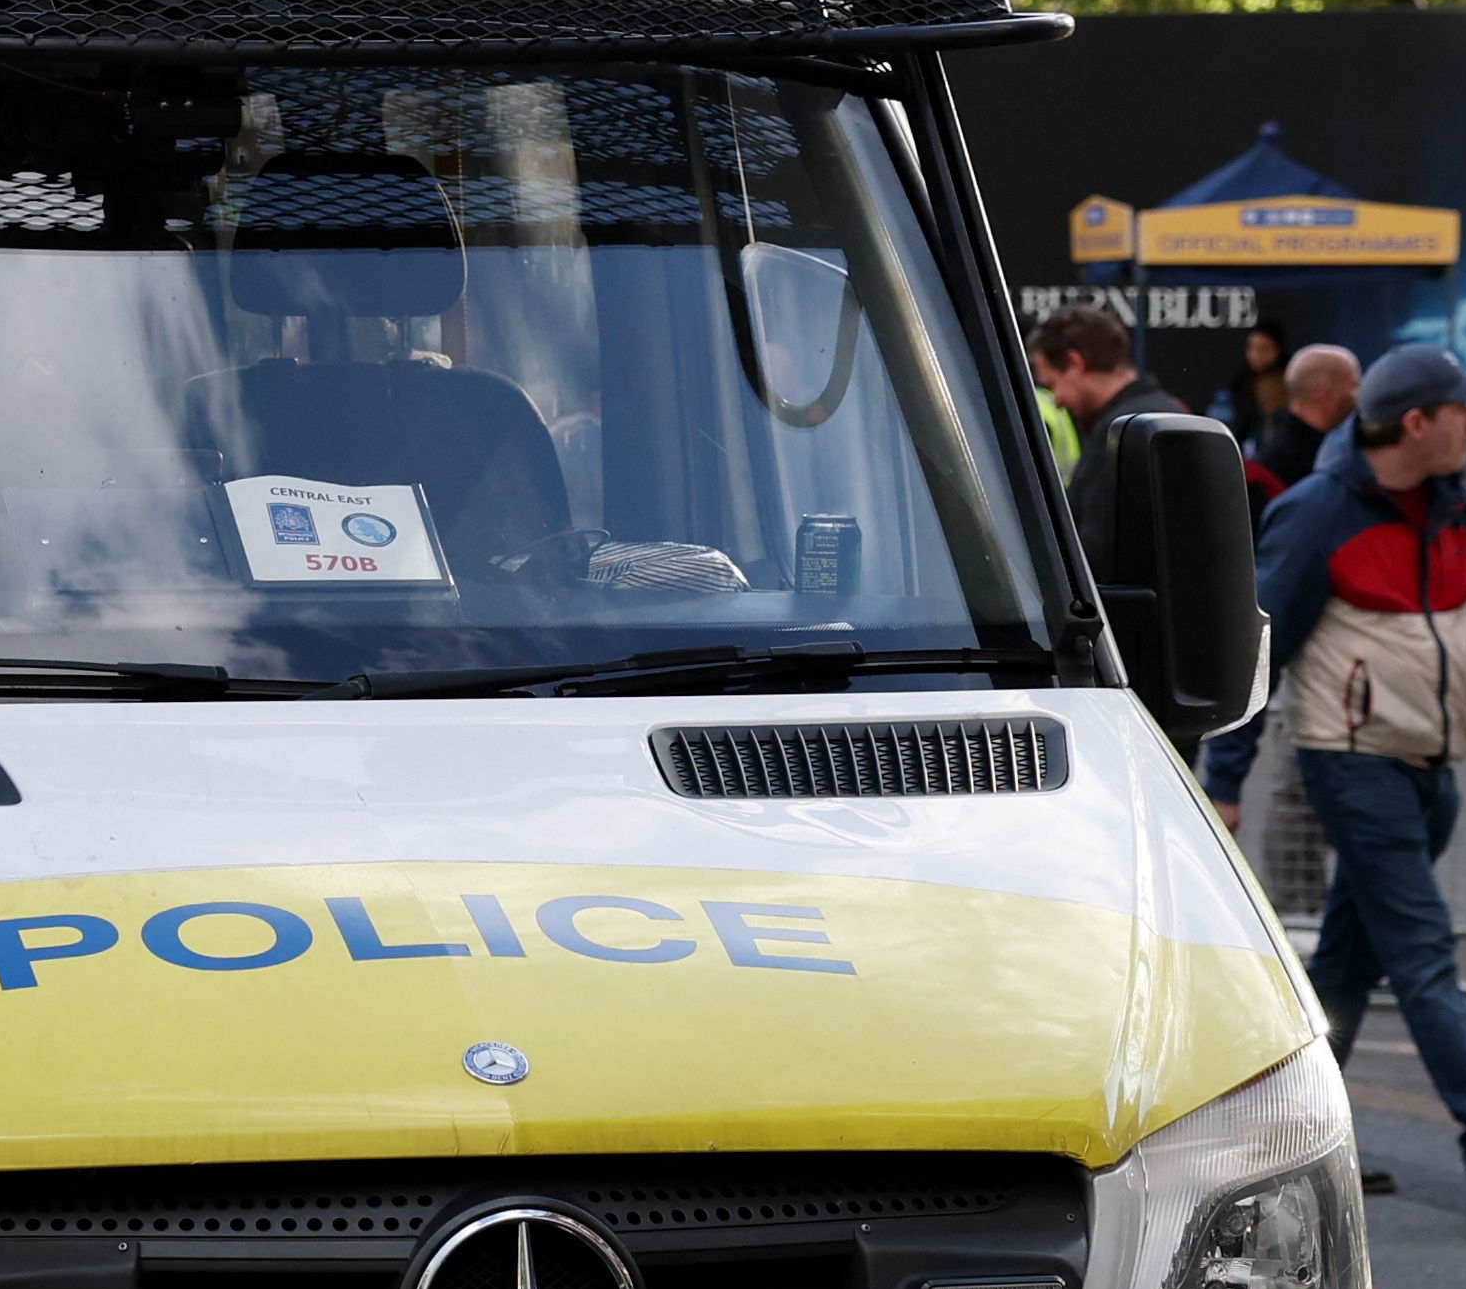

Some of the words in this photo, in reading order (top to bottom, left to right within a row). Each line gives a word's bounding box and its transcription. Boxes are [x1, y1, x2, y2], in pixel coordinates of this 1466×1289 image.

[1156, 232, 1260, 253] OFFICIAL
[1147, 286, 1258, 328] BLUE
[270, 487, 334, 503] CENTRAL
[337, 494, 372, 506] EAST
